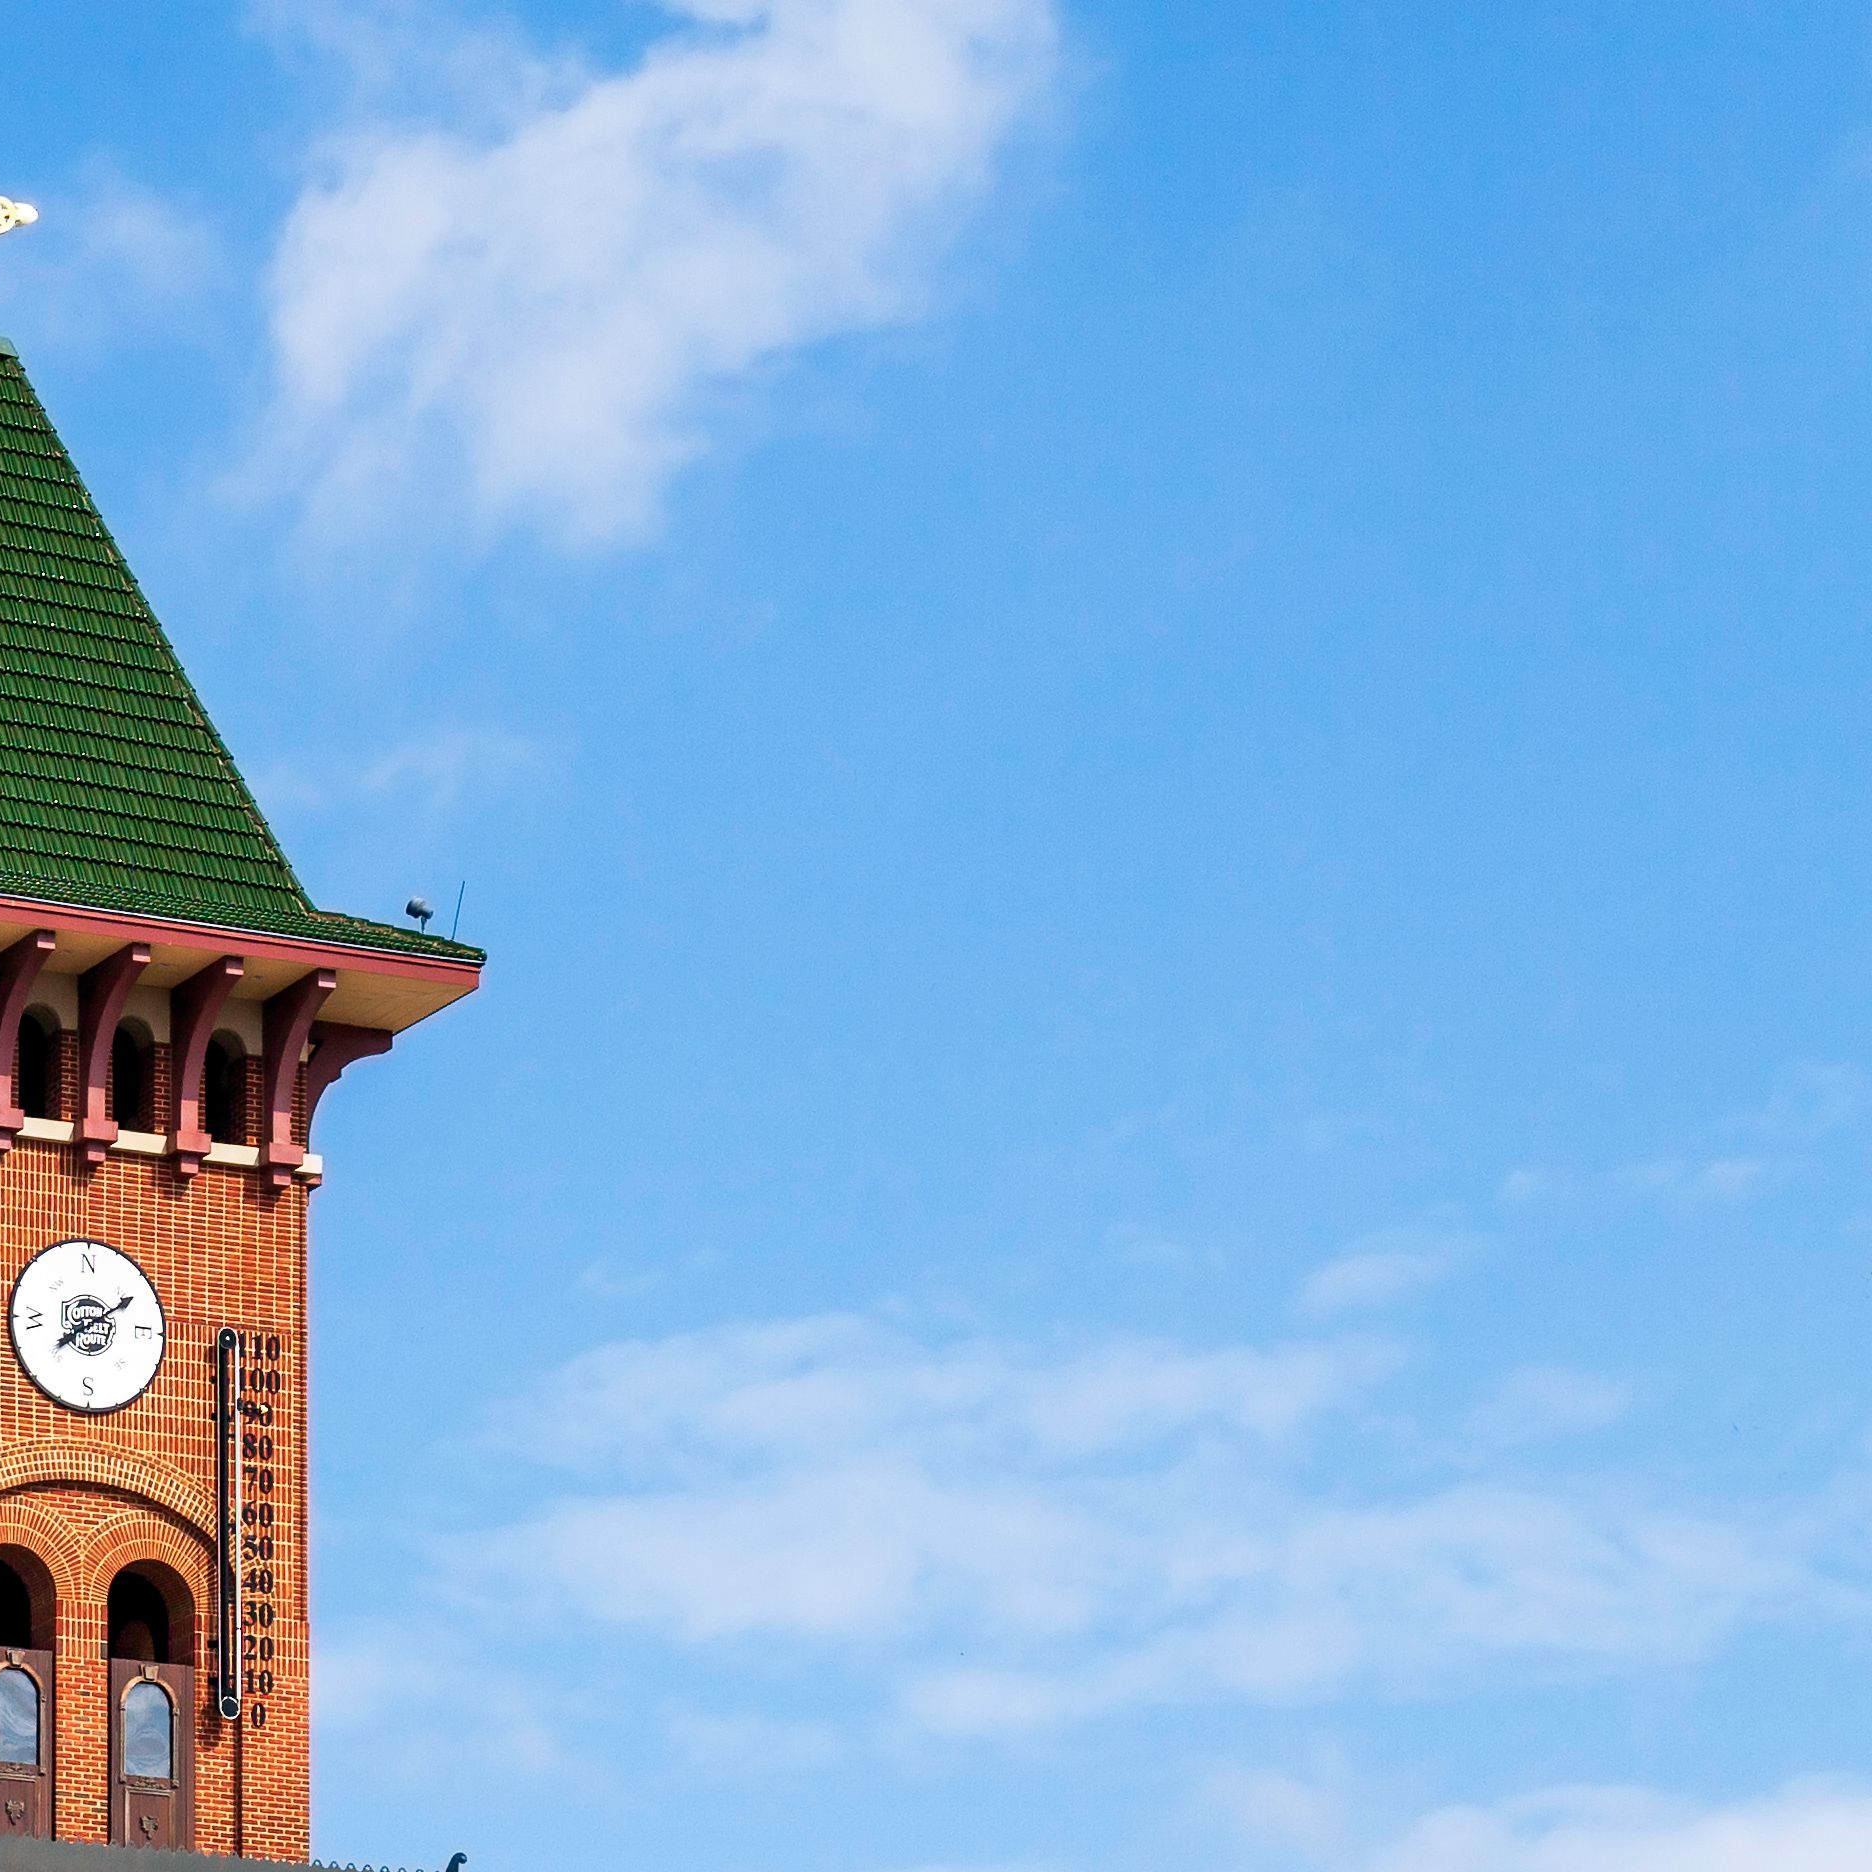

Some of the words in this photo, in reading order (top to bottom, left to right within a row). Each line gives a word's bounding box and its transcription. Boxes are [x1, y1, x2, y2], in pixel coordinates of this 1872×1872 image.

[81, 1253, 96, 1274] N
[26, 1306, 43, 1330] W
[66, 1301, 104, 1326] COTTON
[76, 1333, 107, 1350] ROUTE
[134, 1325, 152, 1339] E
[239, 1332, 280, 1361] 110
[82, 1377, 94, 1396] S
[240, 1367, 280, 1394] 100
[243, 1400, 272, 1426] 90
[243, 1433, 272, 1459] 80
[246, 1465, 273, 1493] 70
[242, 1501, 273, 1527] 60
[243, 1535, 273, 1560] 50
[243, 1568, 273, 1593] 40
[244, 1601, 273, 1627] 30
[244, 1635, 273, 1660] 20
[246, 1669, 273, 1694] 10
[251, 1702, 266, 1727] 0
